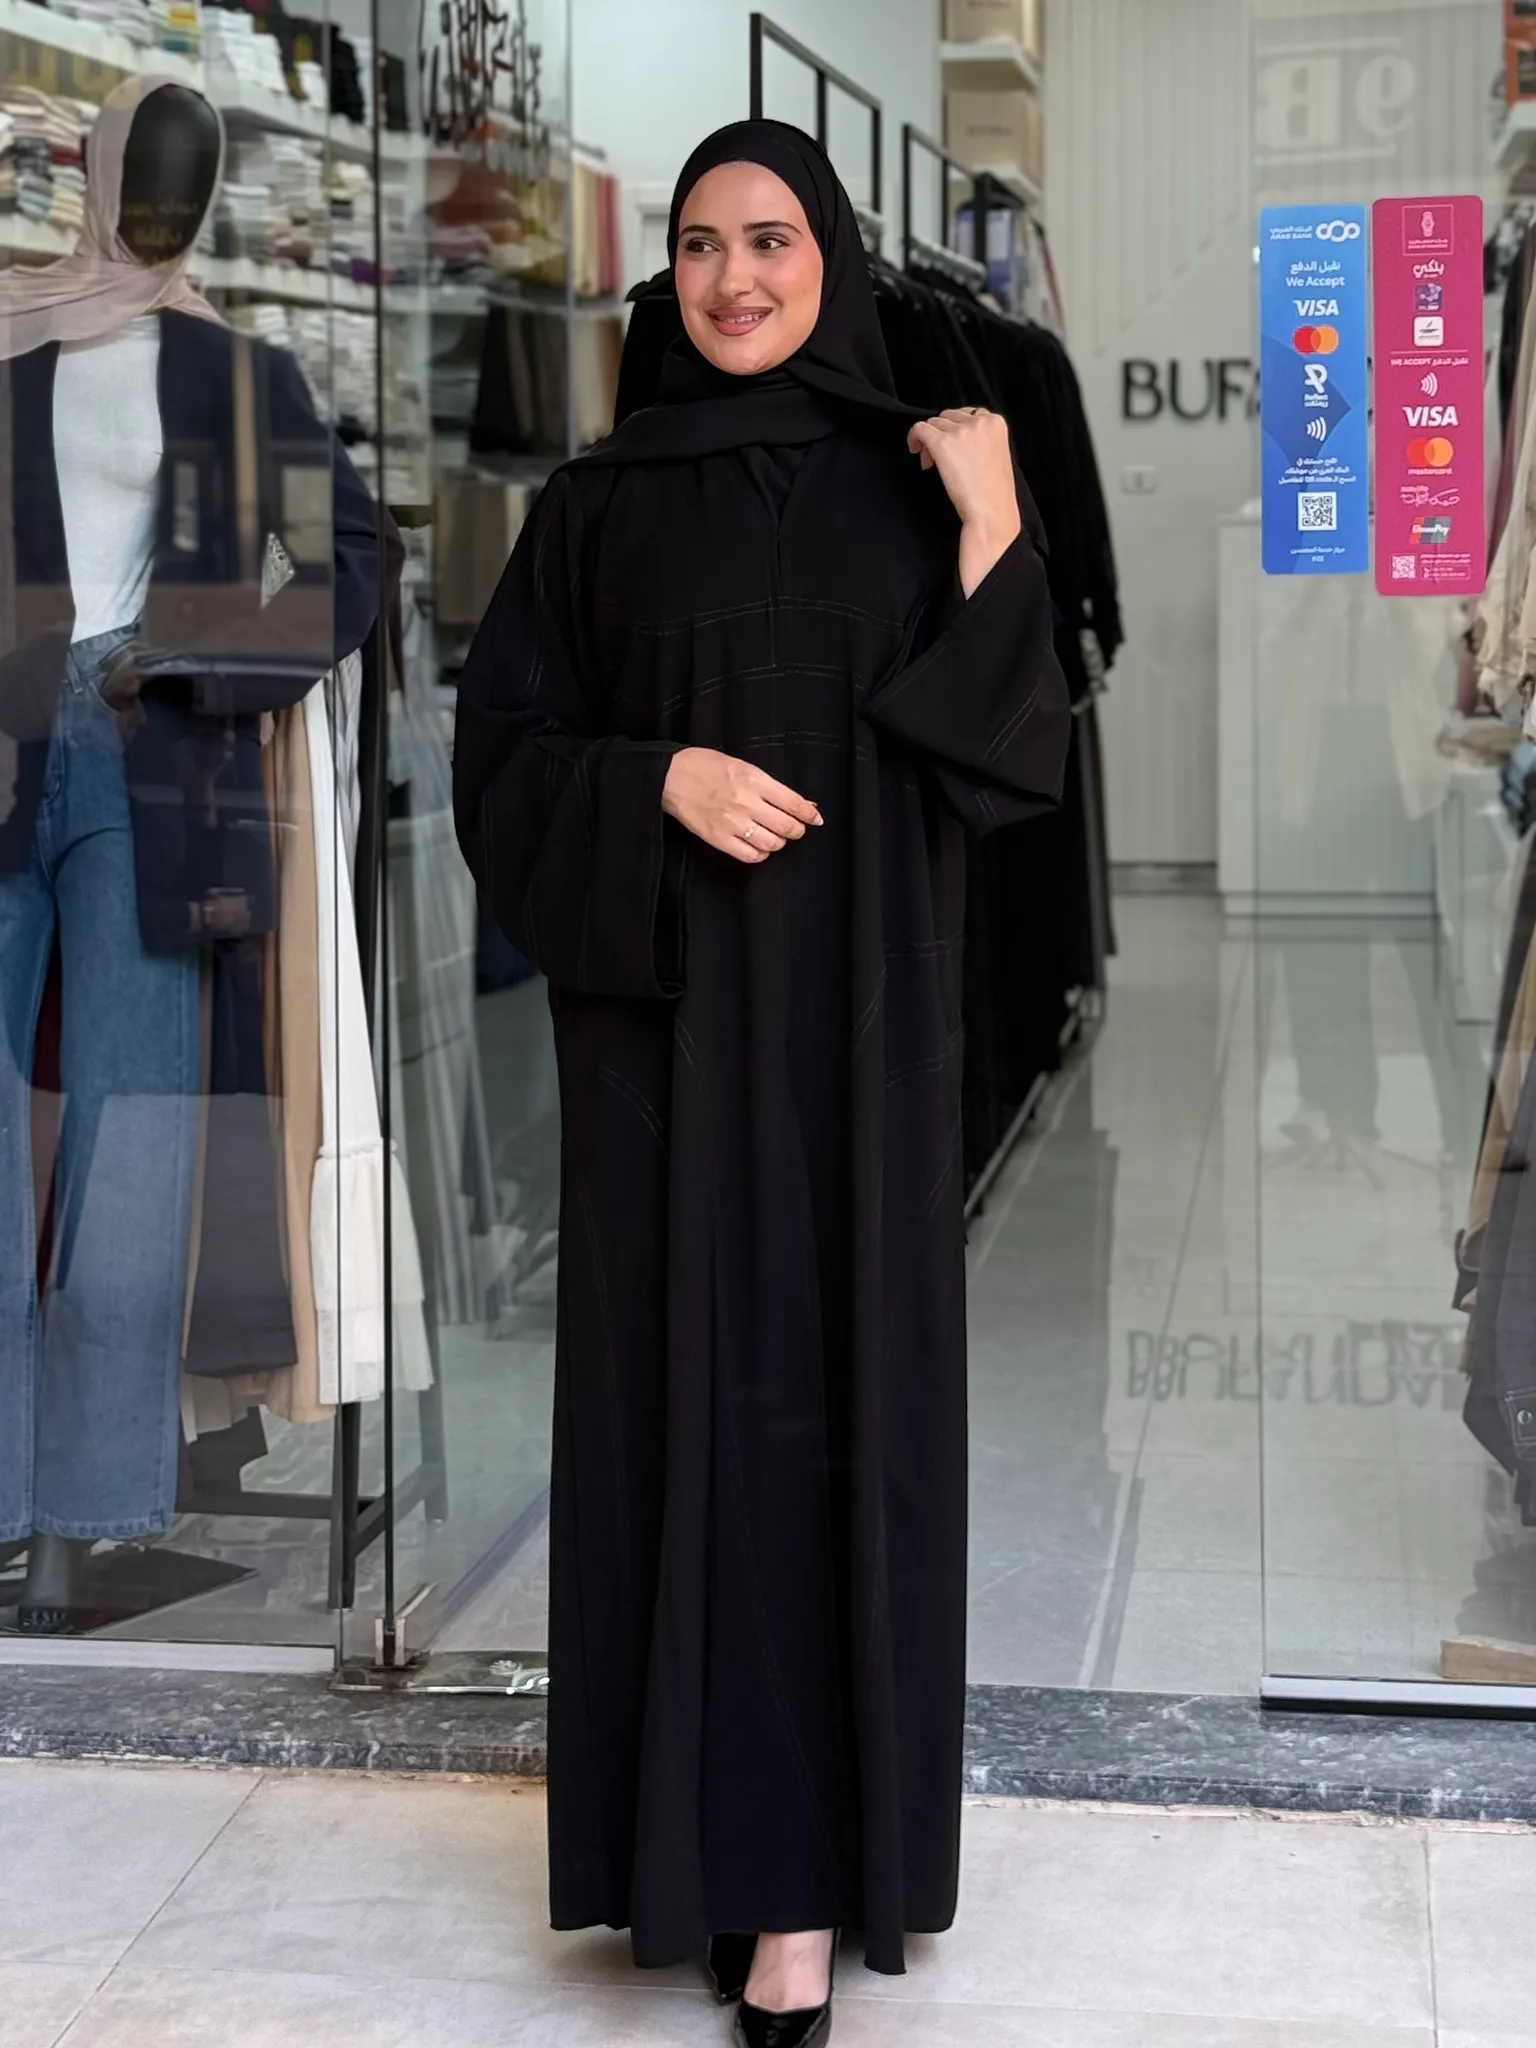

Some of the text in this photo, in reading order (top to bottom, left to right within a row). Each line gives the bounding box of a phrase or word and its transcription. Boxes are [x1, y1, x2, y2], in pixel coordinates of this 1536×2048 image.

[1290, 260, 1341, 275] نقبل الدفع
[1285, 276, 1346, 288] We Accept
[1292, 299, 1340, 317] VISA
[1121, 357, 1261, 422] BUF
[1401, 405, 1460, 428] VISA
